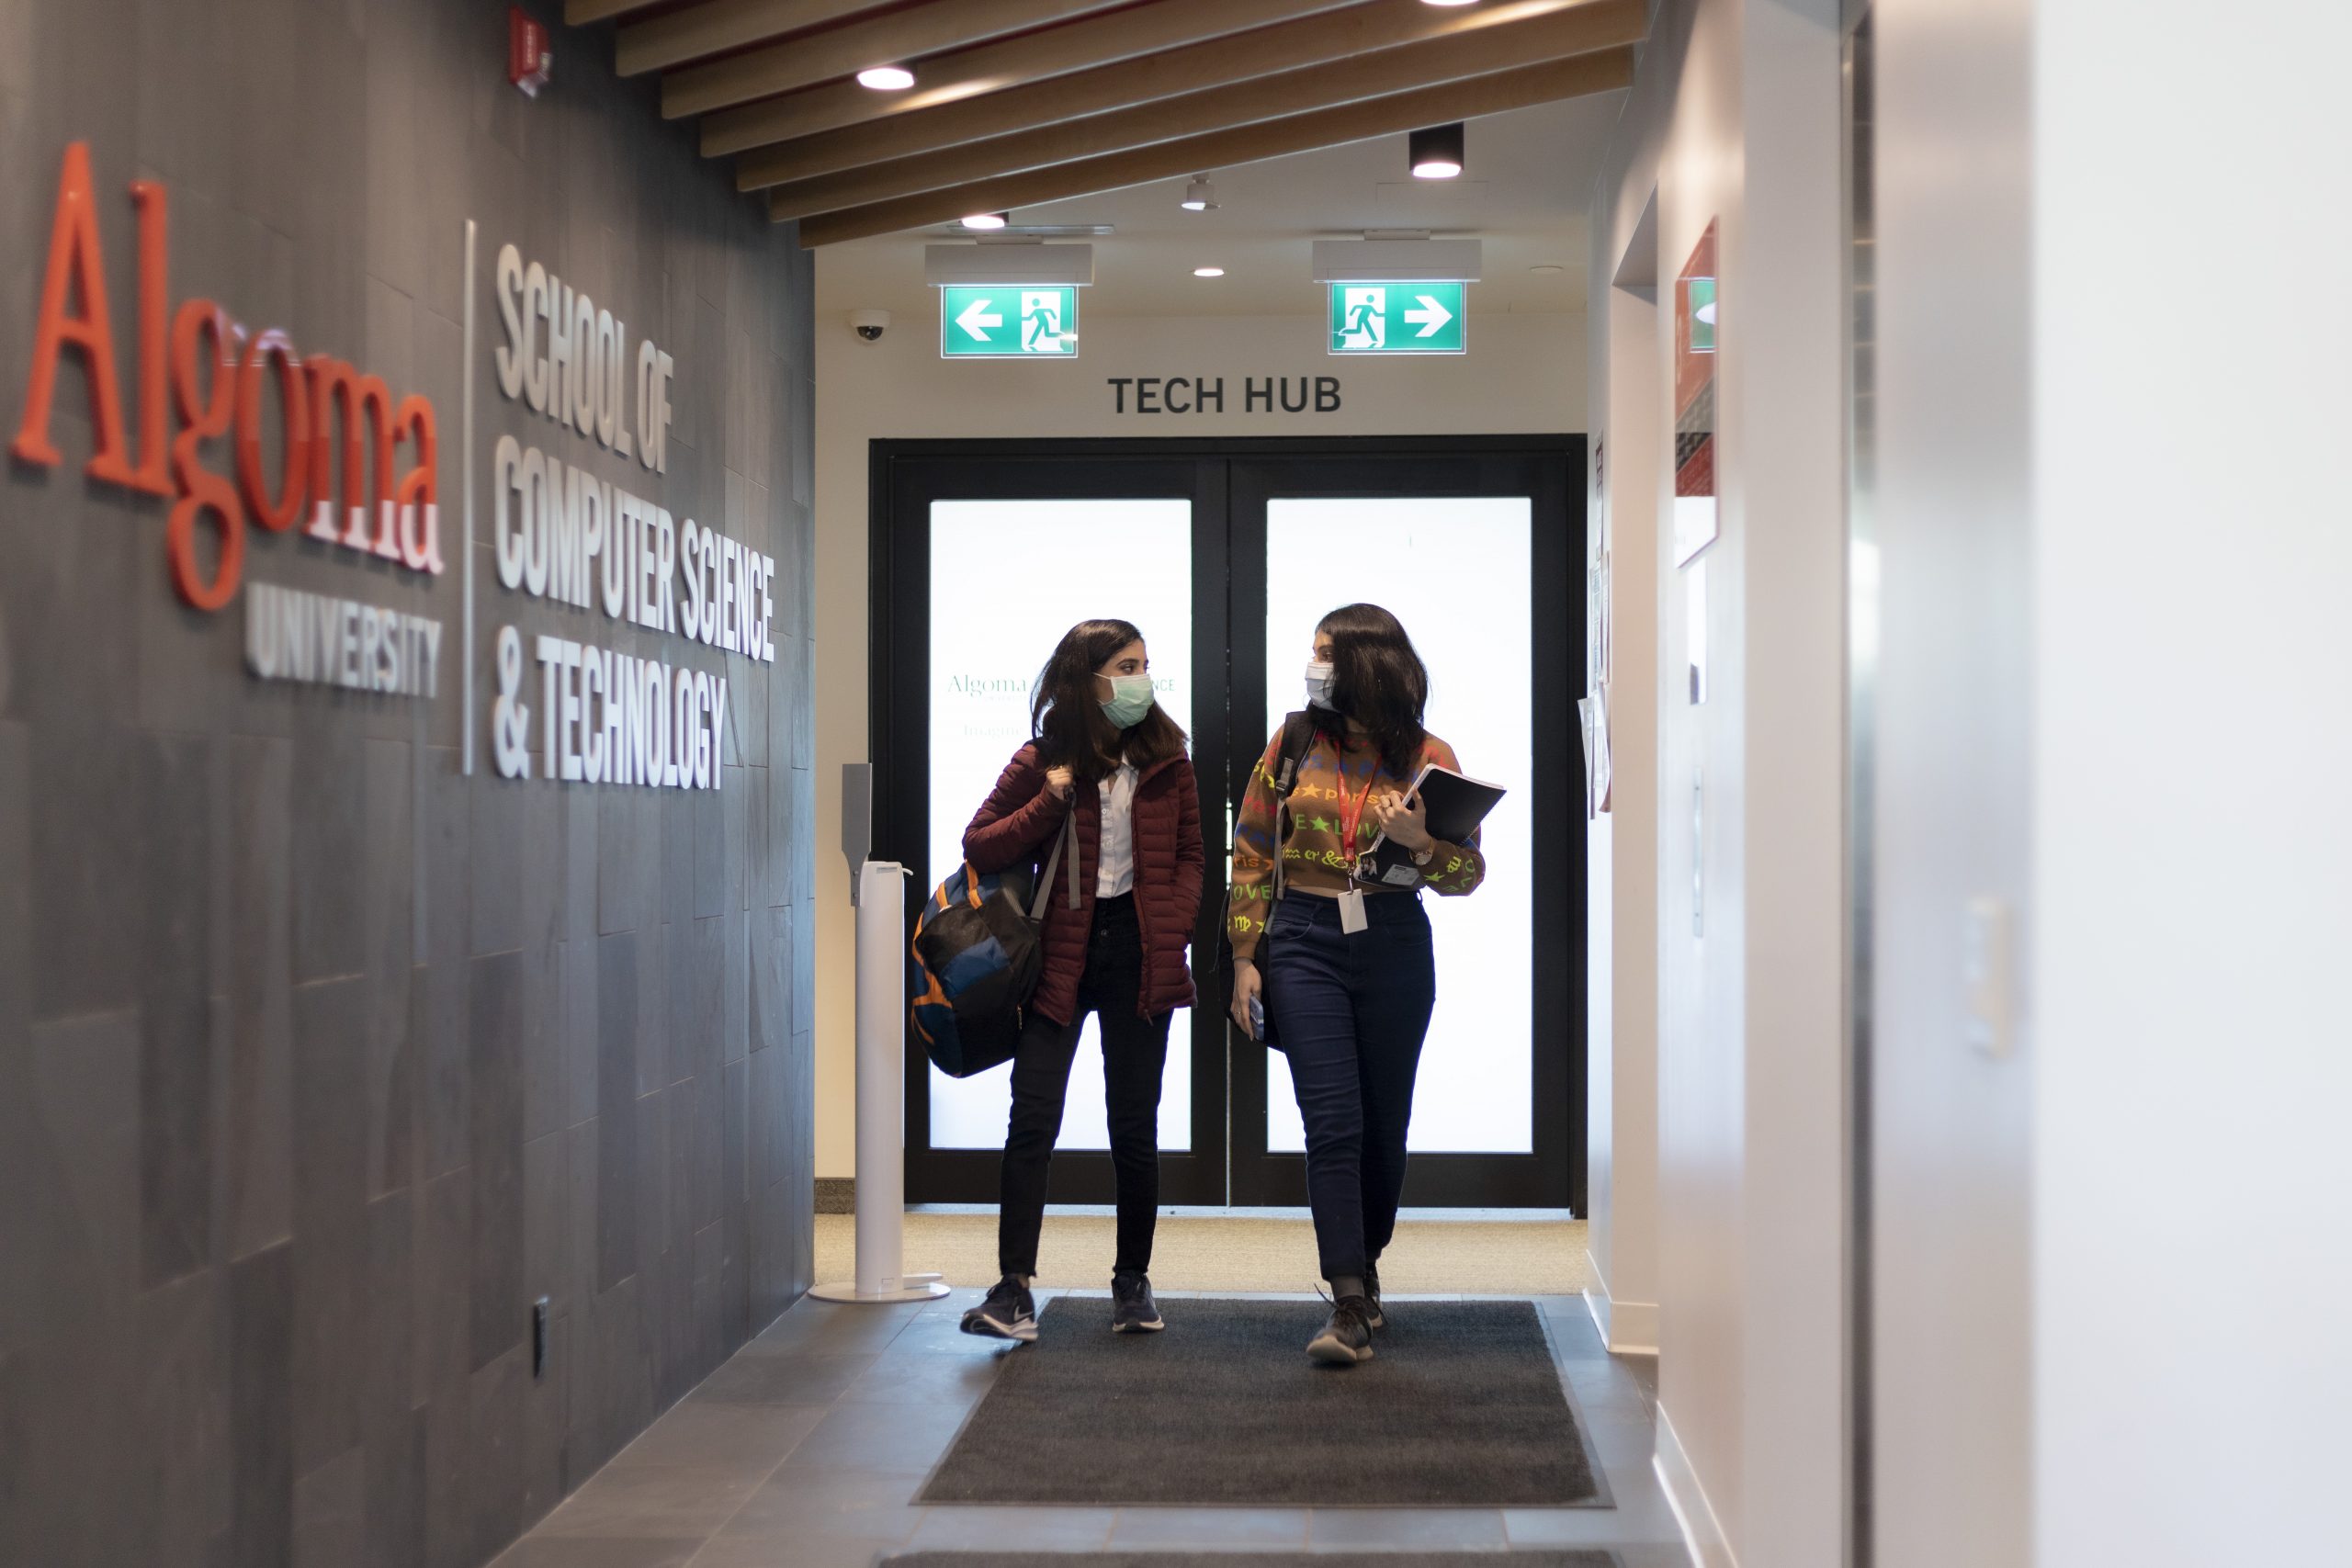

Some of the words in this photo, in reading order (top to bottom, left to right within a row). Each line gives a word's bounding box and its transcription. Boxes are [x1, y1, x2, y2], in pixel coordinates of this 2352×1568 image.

[9, 141, 445, 612] Algoma
[496, 243, 632, 457] SCHOOL
[638, 339, 674, 474] OF
[1107, 377, 1223, 413] TECH
[1245, 377, 1341, 412] HUB
[494, 434, 675, 634] COMPUTER
[680, 518, 775, 662] SCIENCE
[245, 581, 442, 699] UNIVERSITY
[492, 625, 530, 780] &
[536, 635, 727, 790] TECHNOLOGY
[947, 674, 1027, 697] Algoma
